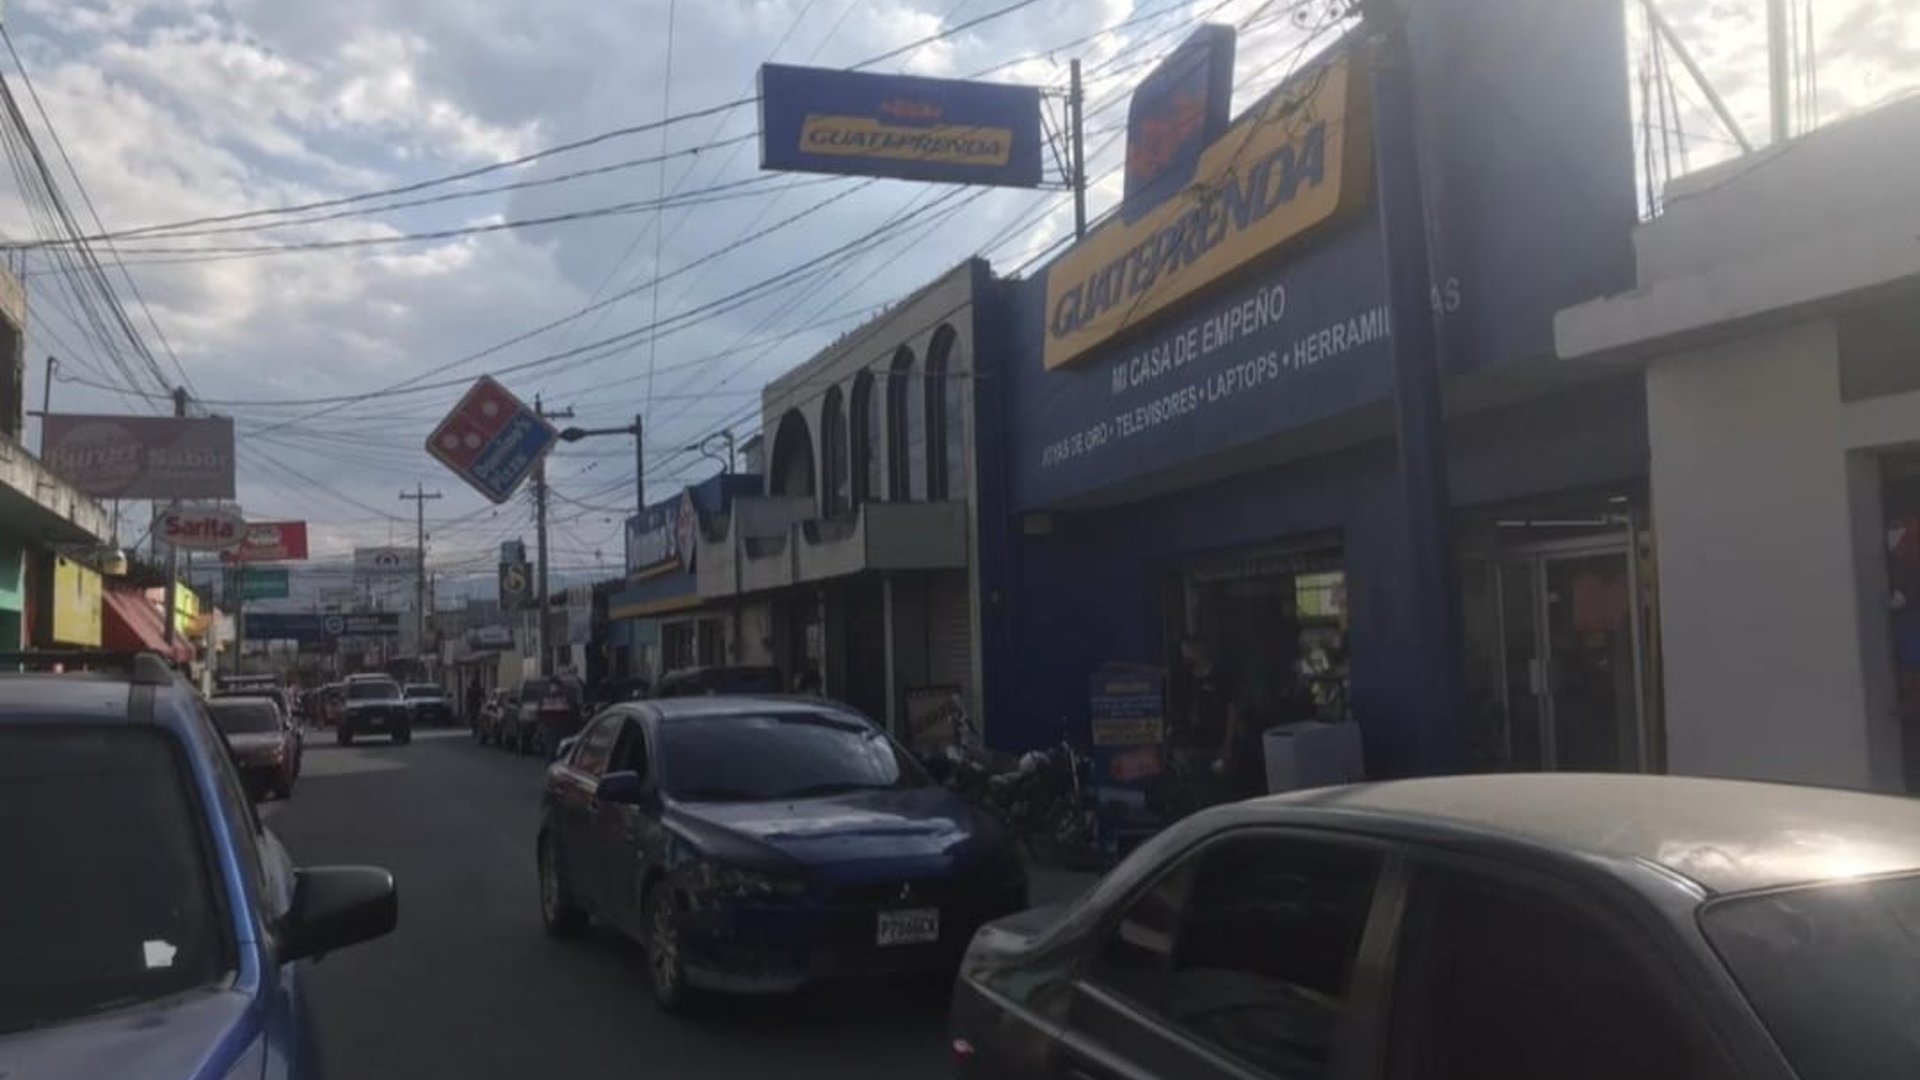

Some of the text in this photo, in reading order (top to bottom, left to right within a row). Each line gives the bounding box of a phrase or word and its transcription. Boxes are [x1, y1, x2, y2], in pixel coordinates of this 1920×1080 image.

[808, 128, 1001, 156] GUATEPRENDA
[1052, 118, 1326, 340] GUATEPRENDA
[1071, 431, 1084, 457] DE
[1084, 421, 1108, 451] ORO
[1115, 384, 1198, 438] TELEVISORES
[1206, 351, 1280, 402] LAPTOPS
[1293, 276, 1462, 370] HERRAMIAS
[1113, 284, 1287, 394] MI CASA DE EMPEÑO
[165, 515, 234, 538] Sarita
